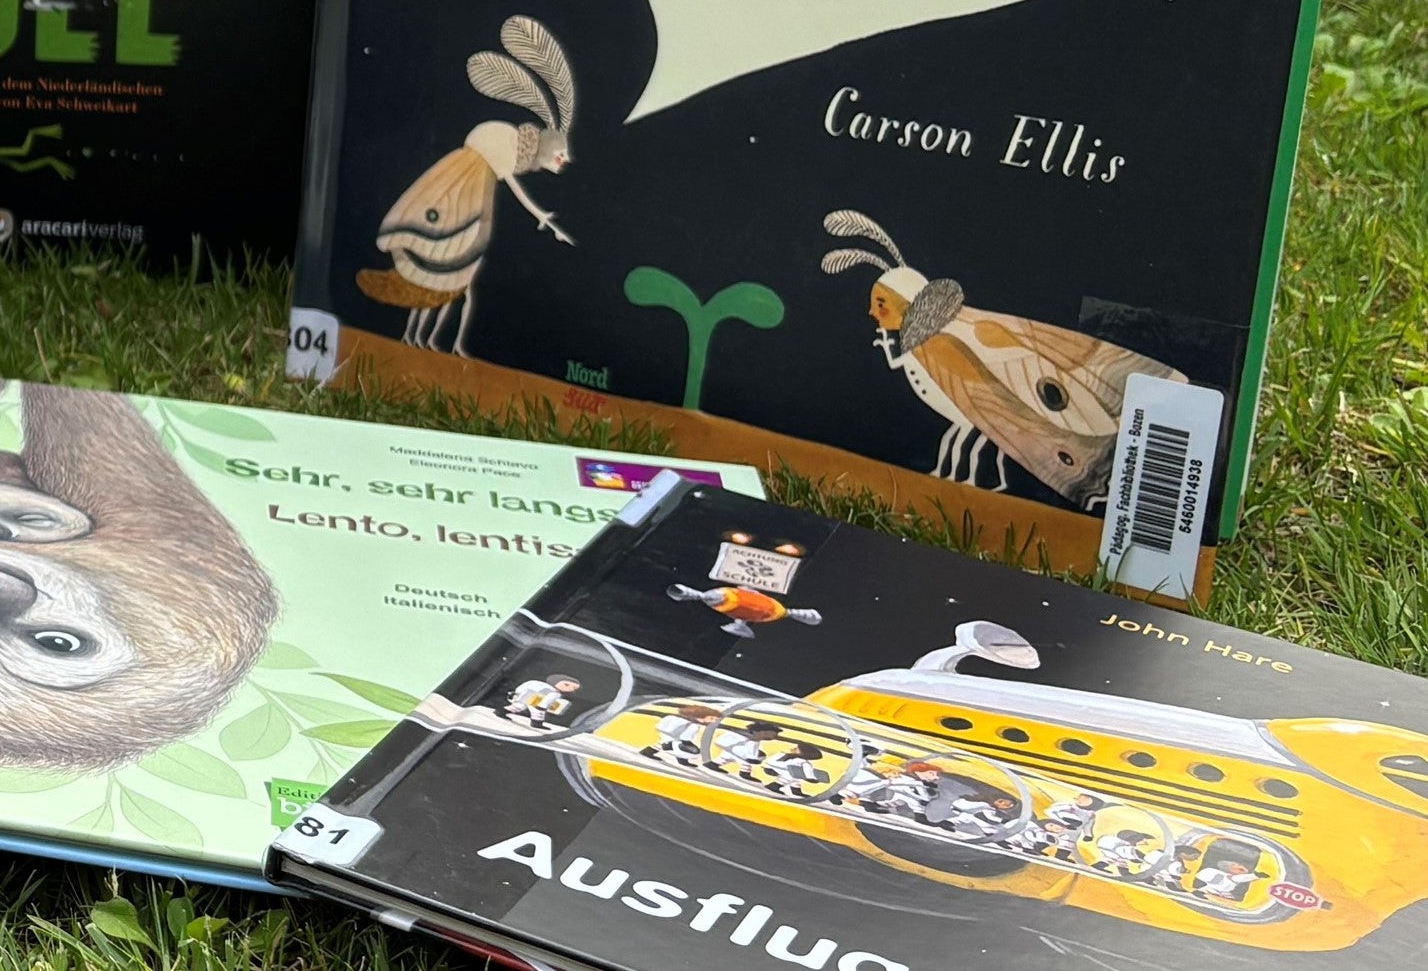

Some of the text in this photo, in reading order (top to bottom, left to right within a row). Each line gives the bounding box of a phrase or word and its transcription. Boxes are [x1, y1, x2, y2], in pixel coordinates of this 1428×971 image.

[2, 76, 33, 91] dem
[25, 95, 53, 110] Eva
[824, 86, 1125, 183] Carson Ellis
[288, 326, 328, 356] 04
[565, 359, 608, 390] Nord
[1116, 444, 1139, 513] Fachbibliothek
[1128, 408, 1145, 437] Bozen
[225, 457, 351, 492] Sehr,
[368, 478, 473, 505] sehr
[1179, 459, 1203, 534] 5460014938
[268, 504, 582, 560] Lento, lentis
[732, 548, 790, 567] ACHTUNG
[394, 582, 489, 605] Deutsch
[722, 570, 781, 589] SCHULE
[383, 595, 502, 620] Italienisch
[1100, 614, 1295, 675] John Hare
[277, 786, 321, 801] Edit
[294, 816, 350, 845] 81
[1273, 886, 1317, 904] STOP
